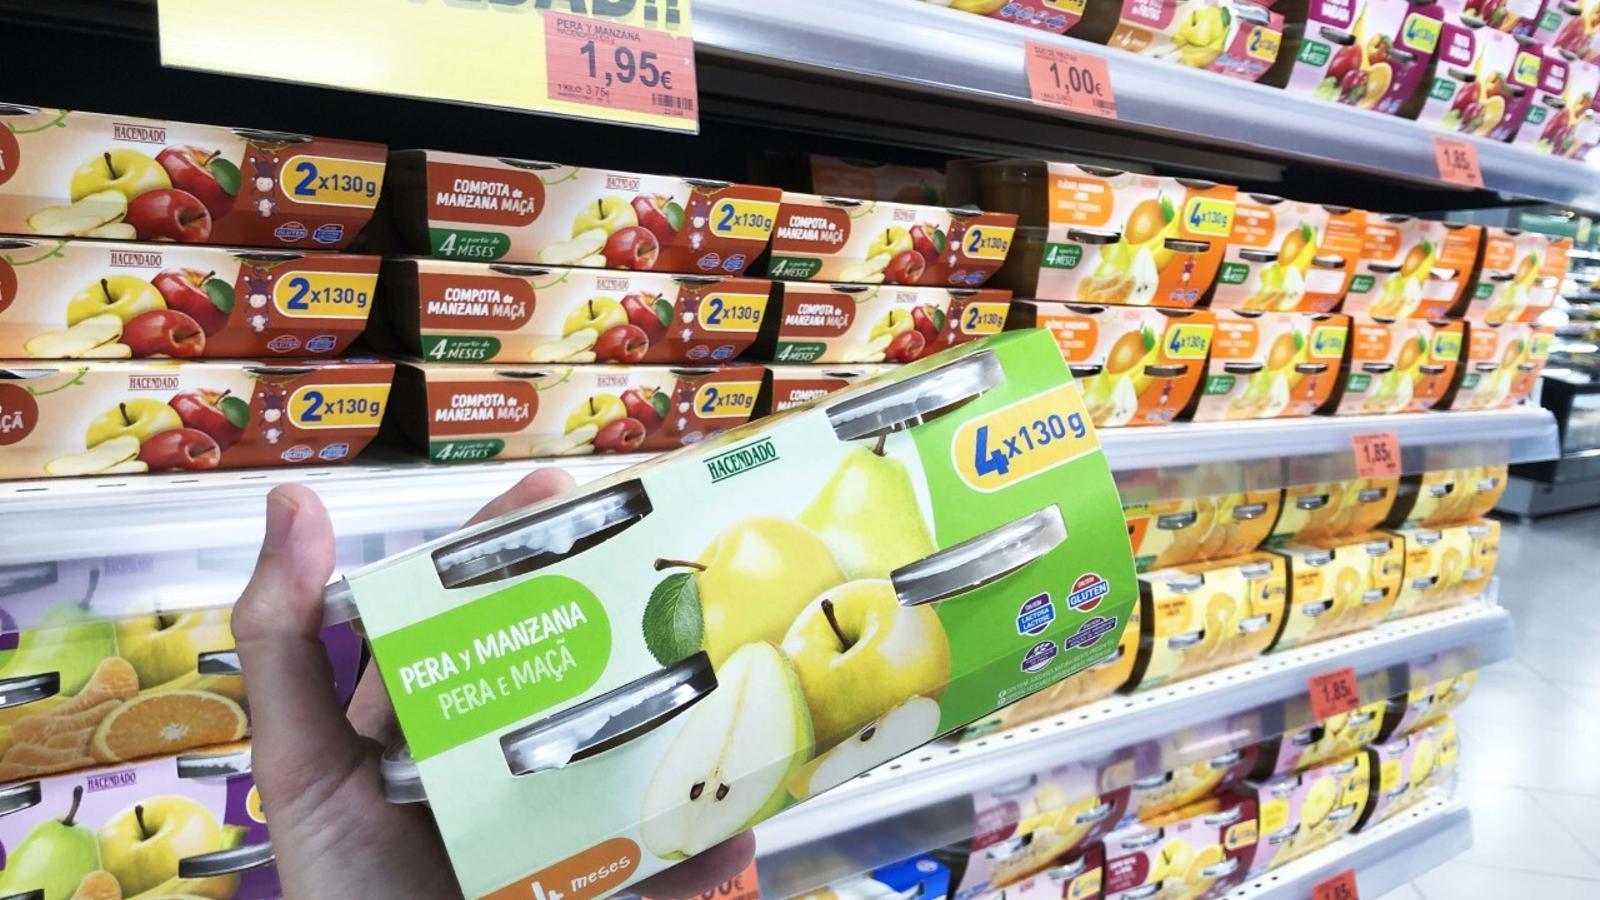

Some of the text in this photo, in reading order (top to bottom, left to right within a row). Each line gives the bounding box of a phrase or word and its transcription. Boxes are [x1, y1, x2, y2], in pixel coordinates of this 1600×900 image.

[556, 18, 584, 32] PERA
[585, 23, 592, 33] Y
[594, 25, 641, 42] MANZANA
[579, 40, 673, 90] 1,95€
[1049, 62, 1104, 96] 1,00€
[113, 124, 166, 143] HACENDADO
[453, 178, 524, 199] COMPOTA de
[436, 192, 536, 216] MANZANA MAÇÃ
[789, 215, 828, 230] COMPOTA
[777, 227, 819, 241] MANZANA
[439, 233, 496, 258] 4 MESES
[1046, 245, 1059, 265] 4
[111, 253, 163, 266] HACENDADO
[771, 259, 788, 277] 4
[782, 268, 811, 278] MESES
[444, 287, 514, 304] COMPOTA de
[427, 301, 526, 321] MANZANA MAÇÃ
[797, 303, 834, 315] COMPOTA
[784, 314, 825, 327] MANZANA
[429, 338, 487, 360] 4 MESES
[777, 344, 794, 361] 4
[129, 377, 180, 389] HACENDADO
[451, 393, 506, 408] COMPOTA
[435, 402, 530, 422] MANZANA MAÇÃ
[435, 443, 490, 460] 4 MESES
[707, 440, 777, 480] HACENDADO
[1069, 582, 1108, 606] GLUTEN
[1021, 607, 1050, 624] LACTOSA
[399, 652, 460, 696] PERA
[473, 600, 588, 666] MANZANA
[437, 637, 577, 721] PERA E MAÇÃ
[87, 771, 137, 790] HACENDADO
[571, 856, 631, 892] meses
